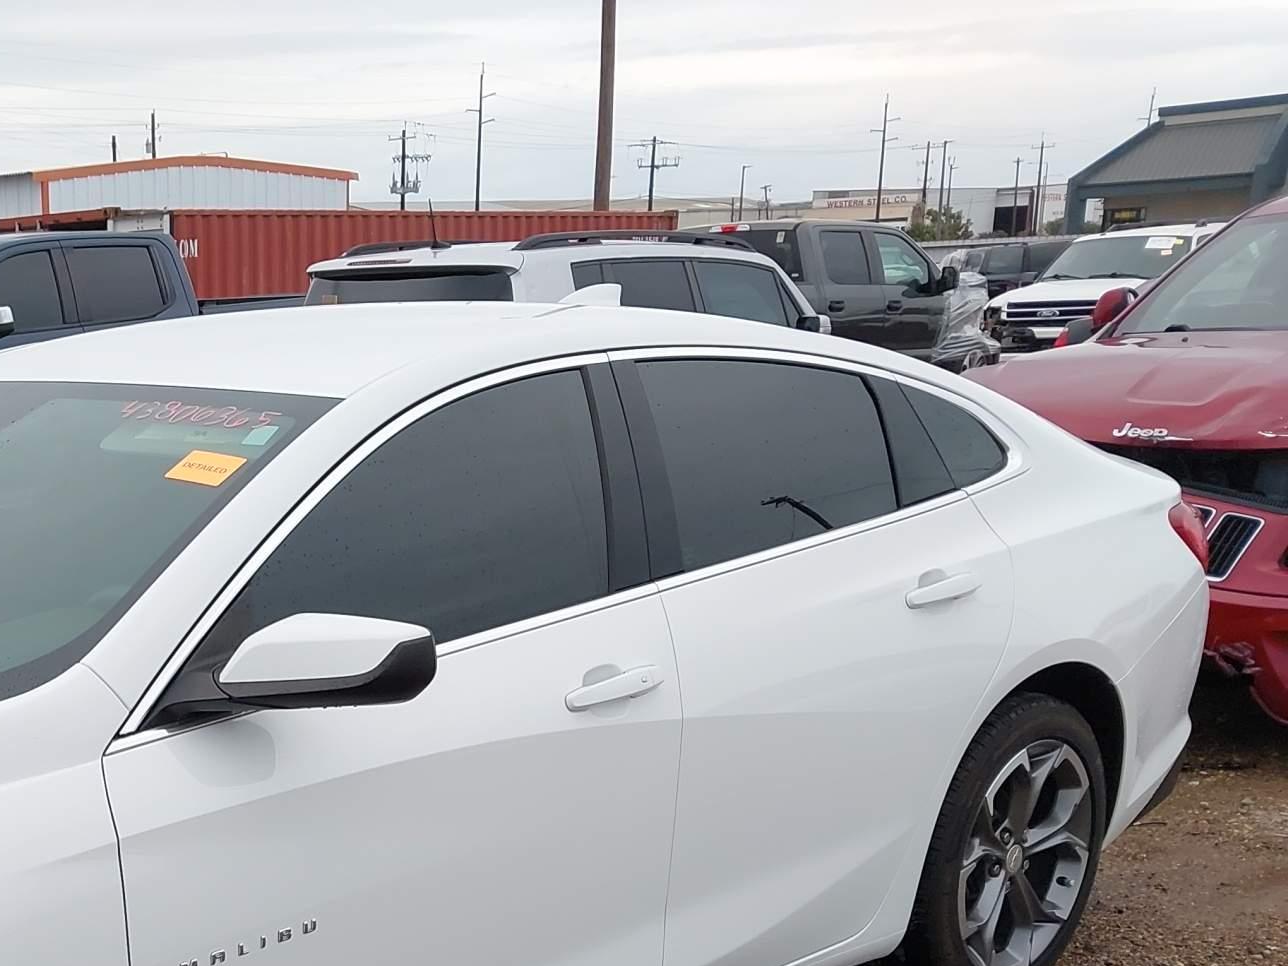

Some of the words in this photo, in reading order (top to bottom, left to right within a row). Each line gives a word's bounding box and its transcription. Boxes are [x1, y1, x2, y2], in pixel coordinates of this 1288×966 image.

[827, 199, 864, 208] WESTERN
[866, 198, 891, 206] STEL
[1112, 422, 1168, 439] Jeep
[182, 461, 229, 475] DETAILED
